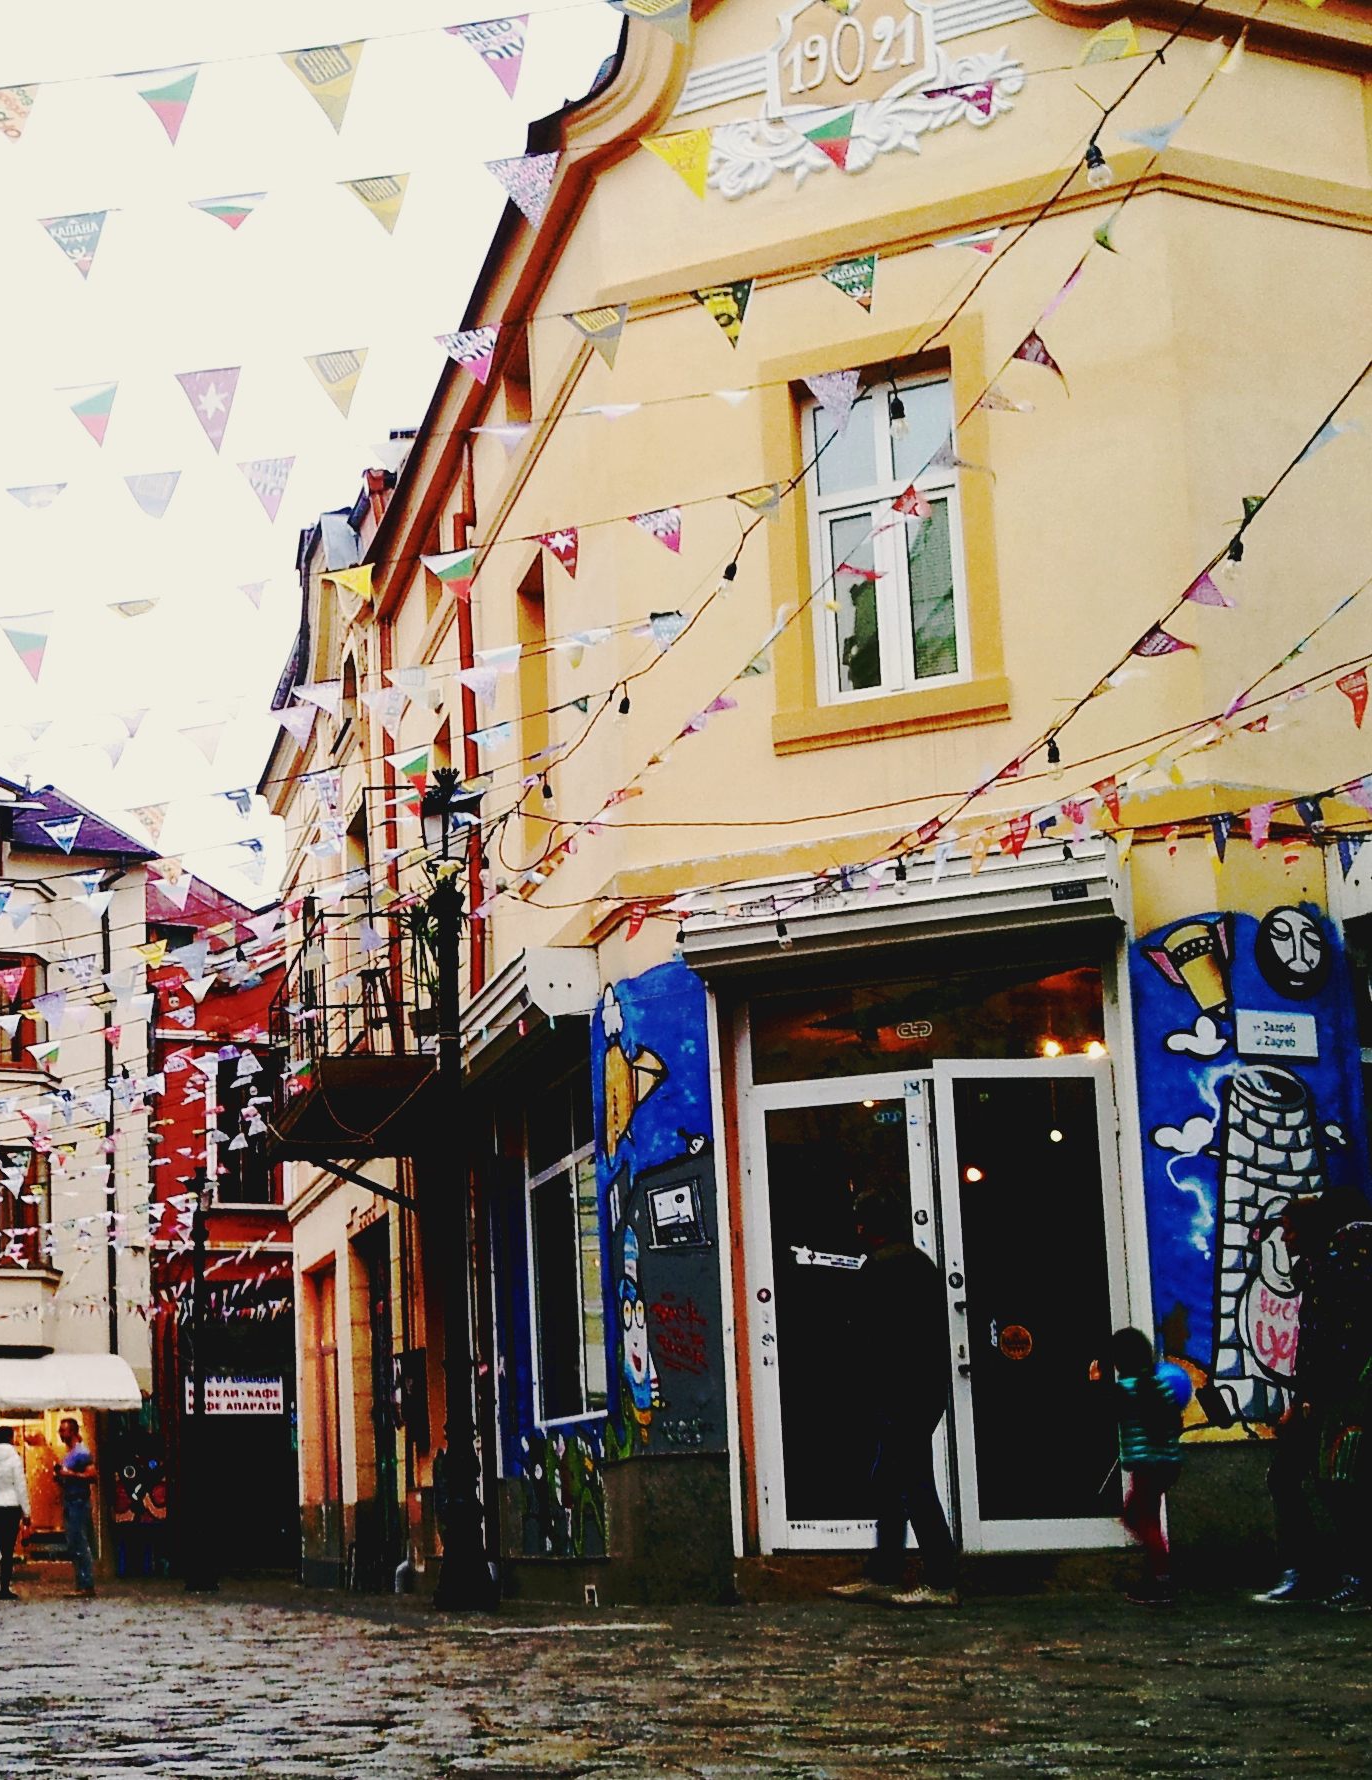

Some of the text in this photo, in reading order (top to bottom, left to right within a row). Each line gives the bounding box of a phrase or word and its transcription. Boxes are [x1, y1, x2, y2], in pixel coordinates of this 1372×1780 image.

[464, 20, 513, 44] NEED
[1264, 1035, 1296, 1049] Zagreb
[247, 1389, 280, 1398] КАФЕ
[226, 1402, 281, 1411] АПАРАТИ
